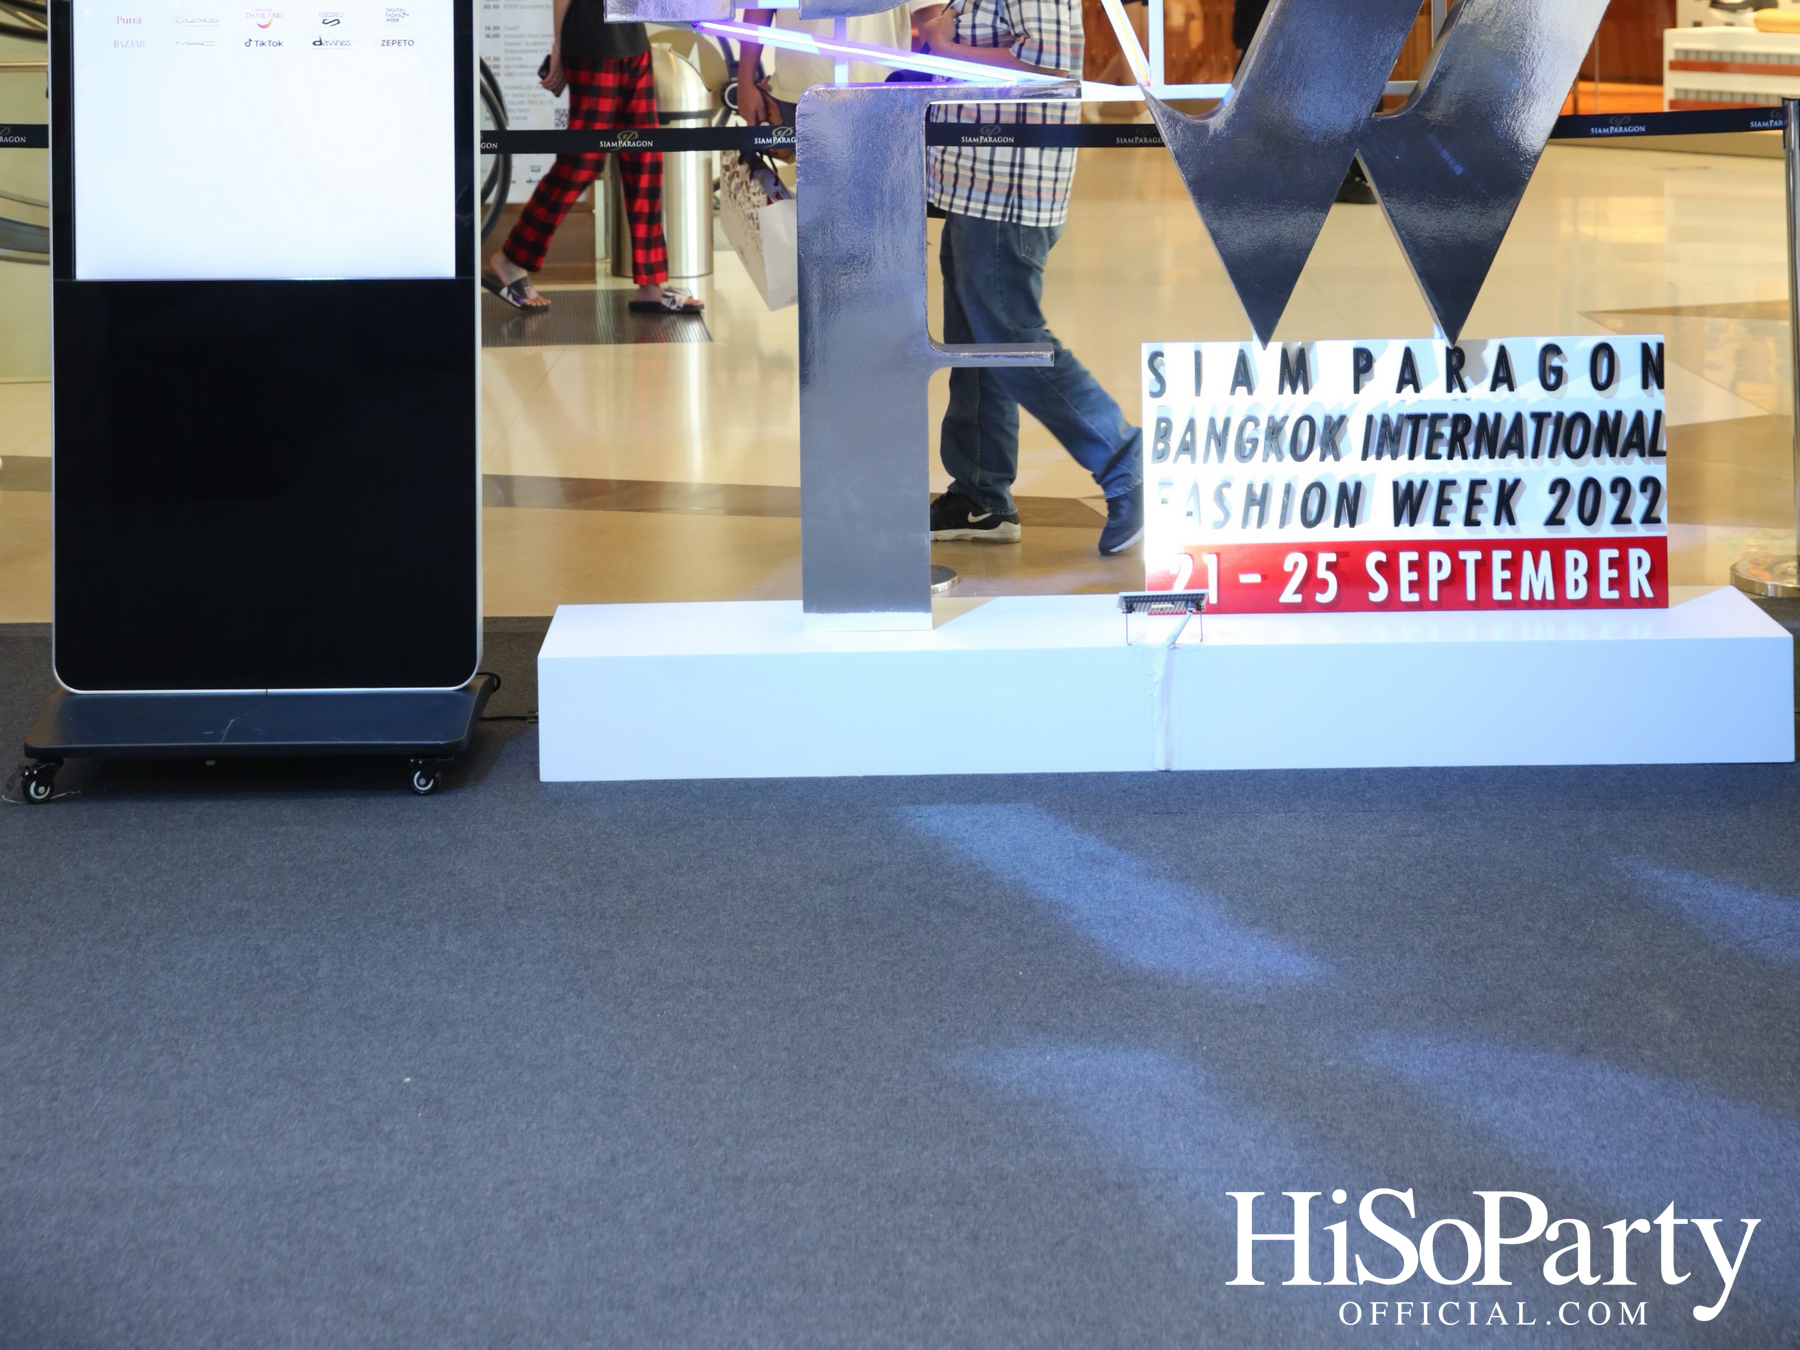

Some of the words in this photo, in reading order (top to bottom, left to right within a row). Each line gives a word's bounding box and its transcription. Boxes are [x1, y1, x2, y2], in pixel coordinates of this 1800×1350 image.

[381, 39, 415, 47] ZEPETO
[1147, 347, 1310, 398] SIAM
[1353, 341, 1664, 394] PARAGON
[1151, 415, 1345, 464] BANGKOK
[1361, 409, 1667, 461] INTERNATIONAL
[1392, 478, 1521, 527] WEEK
[1543, 476, 1662, 526] 2022
[1280, 551, 1338, 604] 25
[1365, 547, 1654, 603] SEPTEMBER
